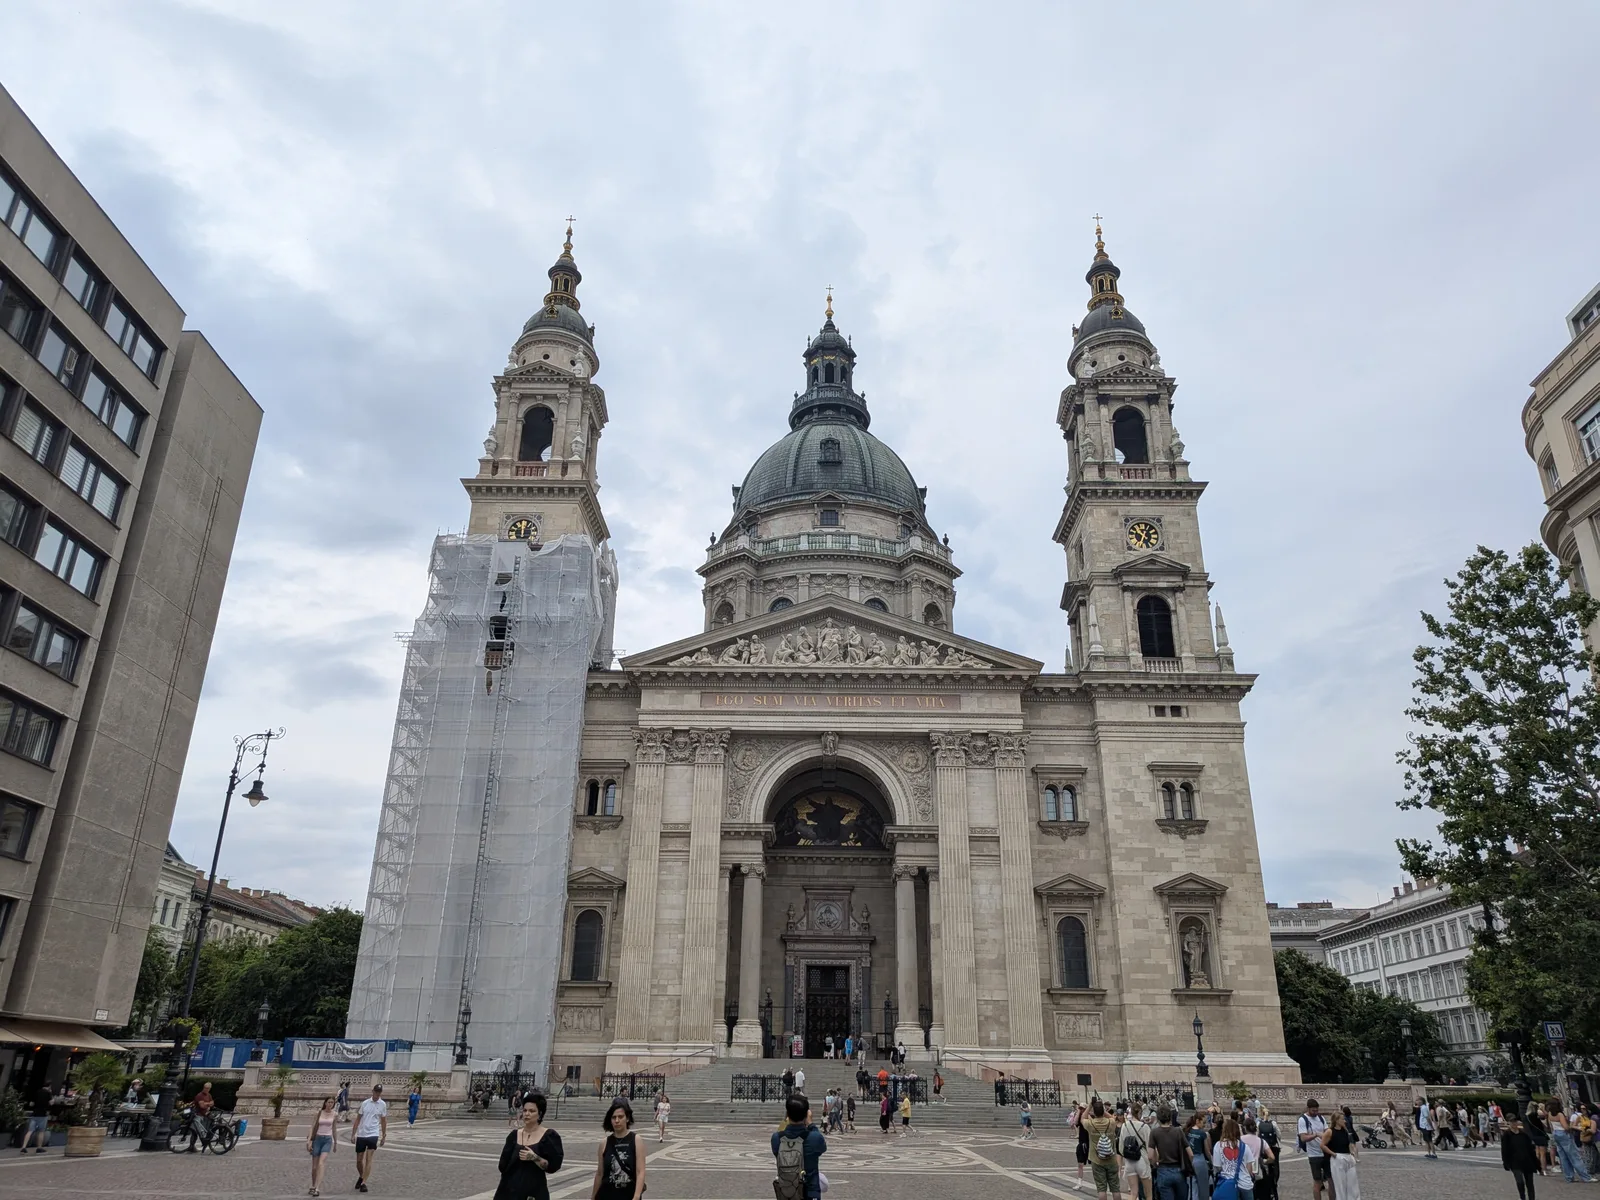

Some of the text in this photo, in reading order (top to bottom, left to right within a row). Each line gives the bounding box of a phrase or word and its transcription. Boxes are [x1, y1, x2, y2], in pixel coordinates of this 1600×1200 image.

[715, 695, 946, 708] EGO SUM VIA VERITAS ET VITA
